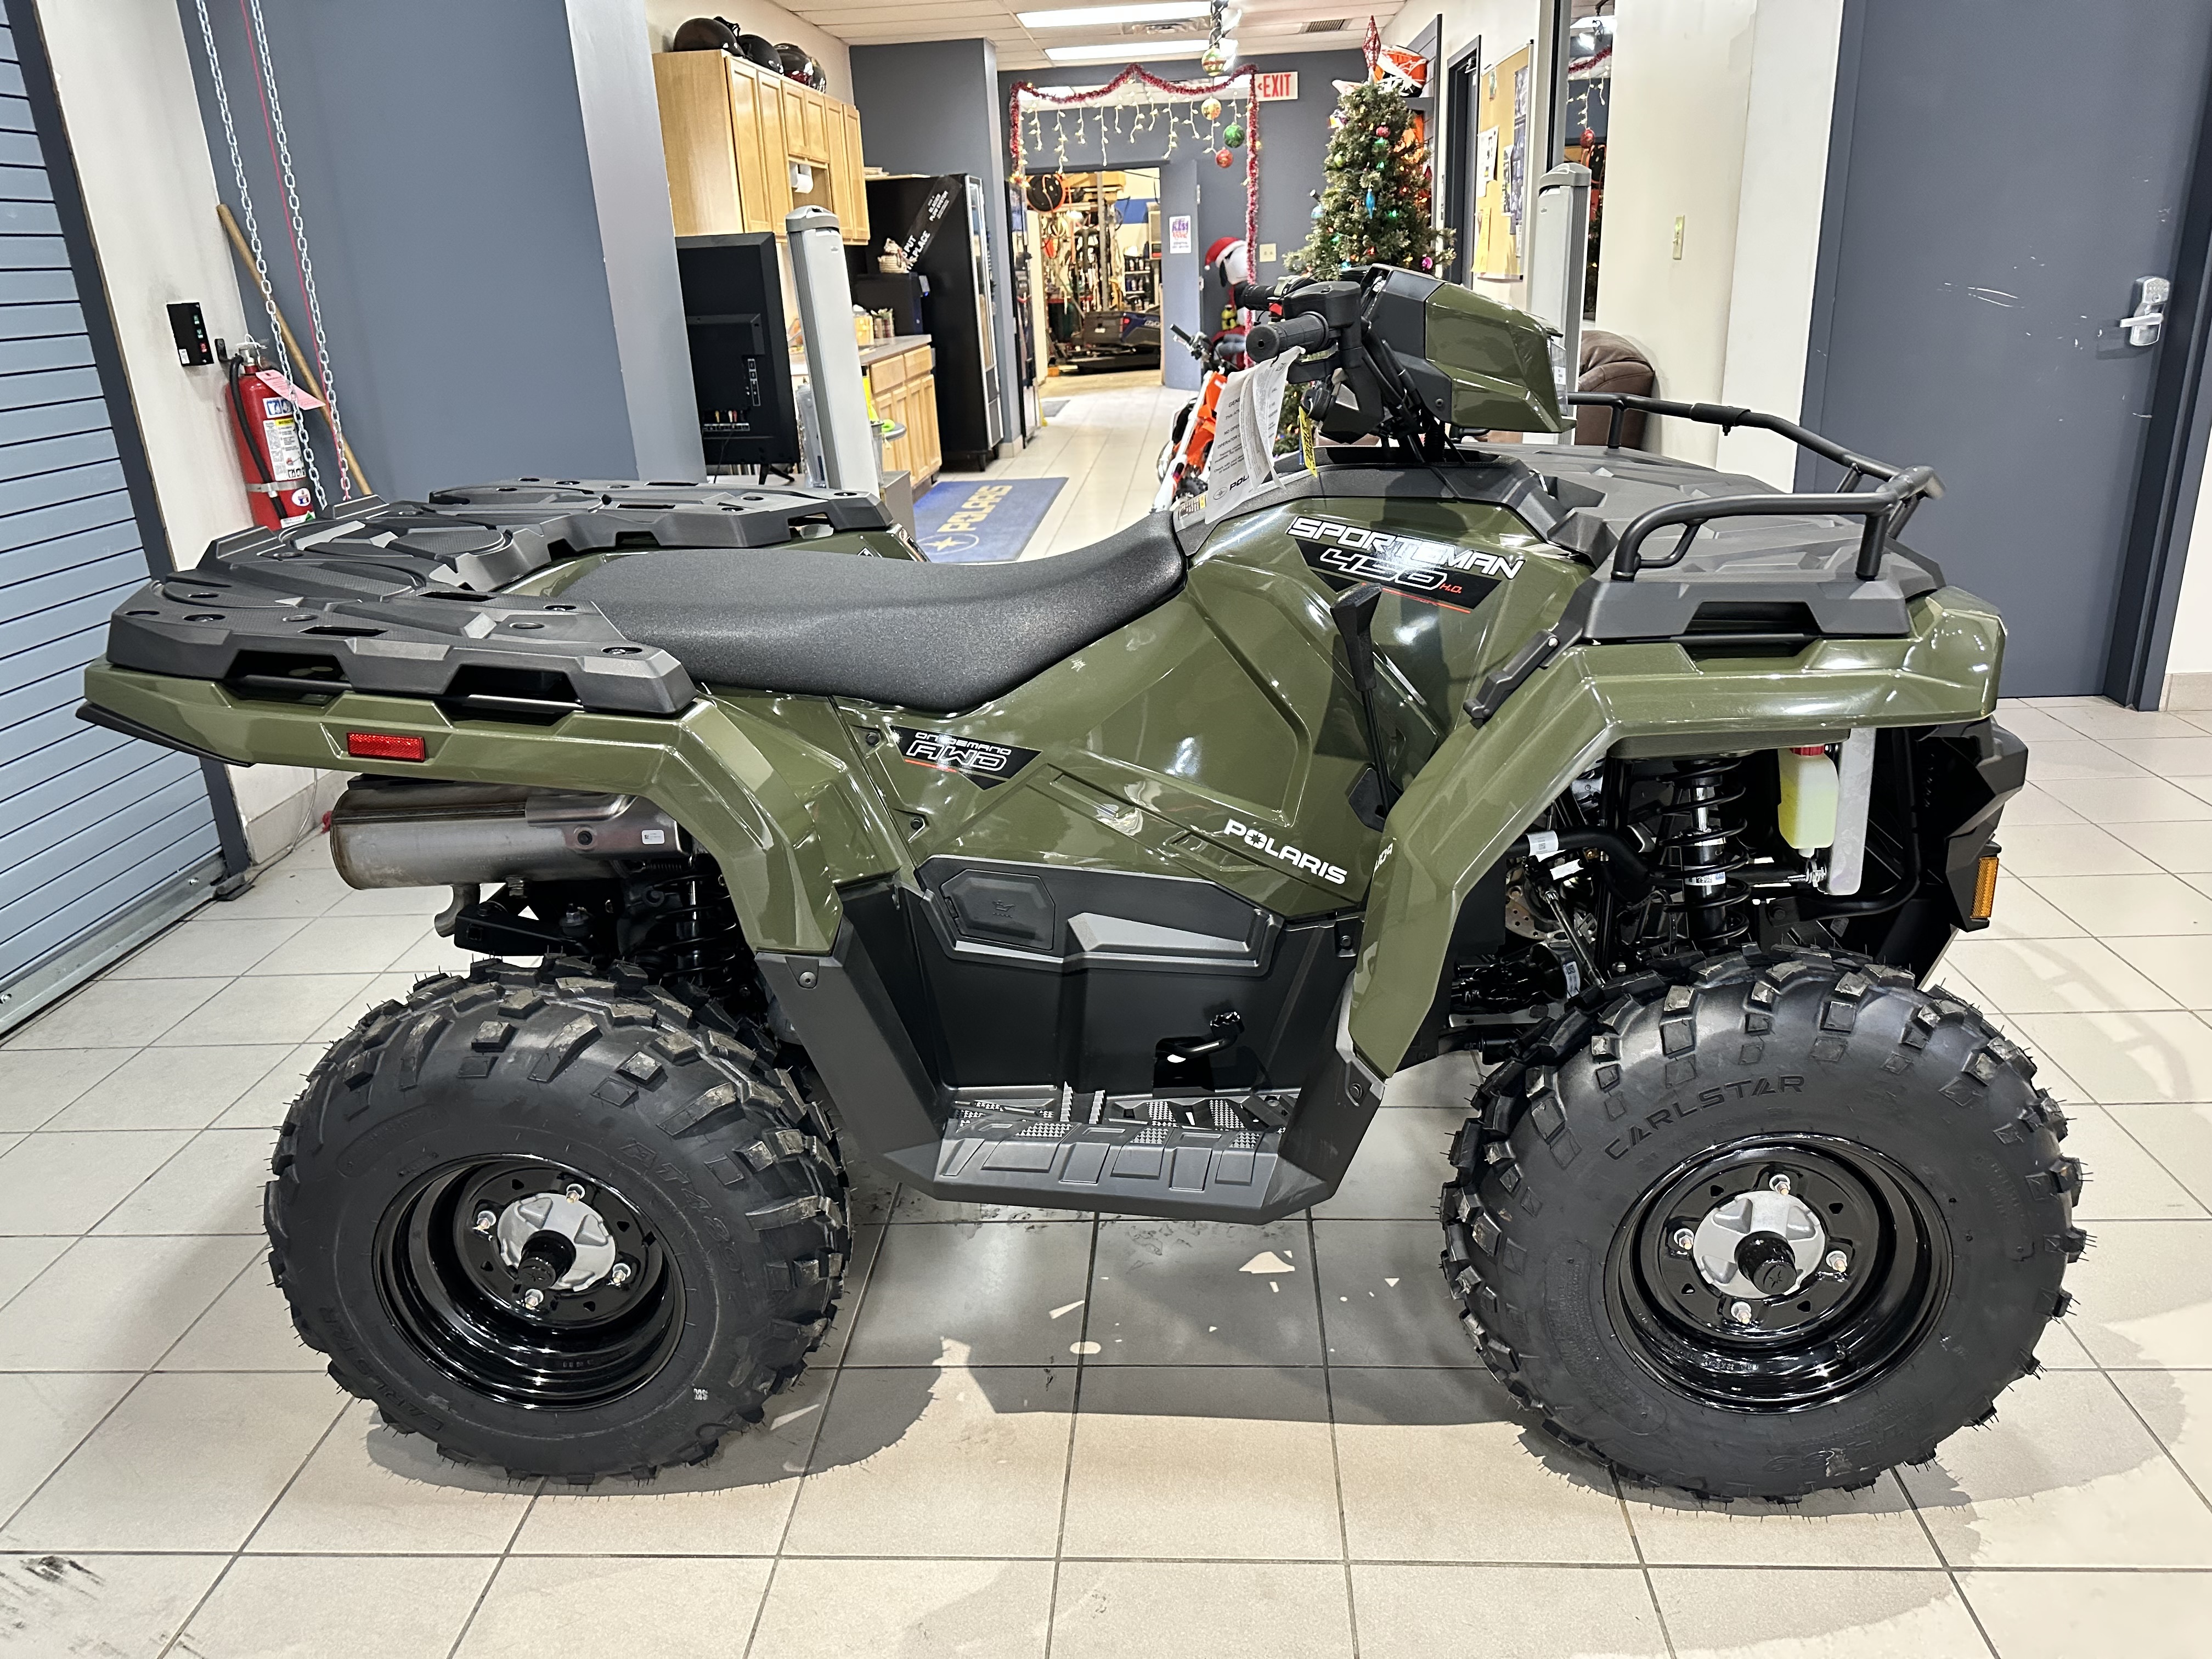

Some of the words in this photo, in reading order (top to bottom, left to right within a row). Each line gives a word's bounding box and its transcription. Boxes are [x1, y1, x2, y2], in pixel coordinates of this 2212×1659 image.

[1263, 74, 1291, 98] EXIT
[904, 235, 916, 252] PUT
[912, 230, 930, 257] PLACE
[1229, 474, 1250, 491] POL
[1285, 516, 1526, 579] SPORTSMAN
[906, 740, 1007, 771] AWD
[1223, 819, 1347, 884] POLARIS
[1604, 1075, 1805, 1161] CARLSTAR
